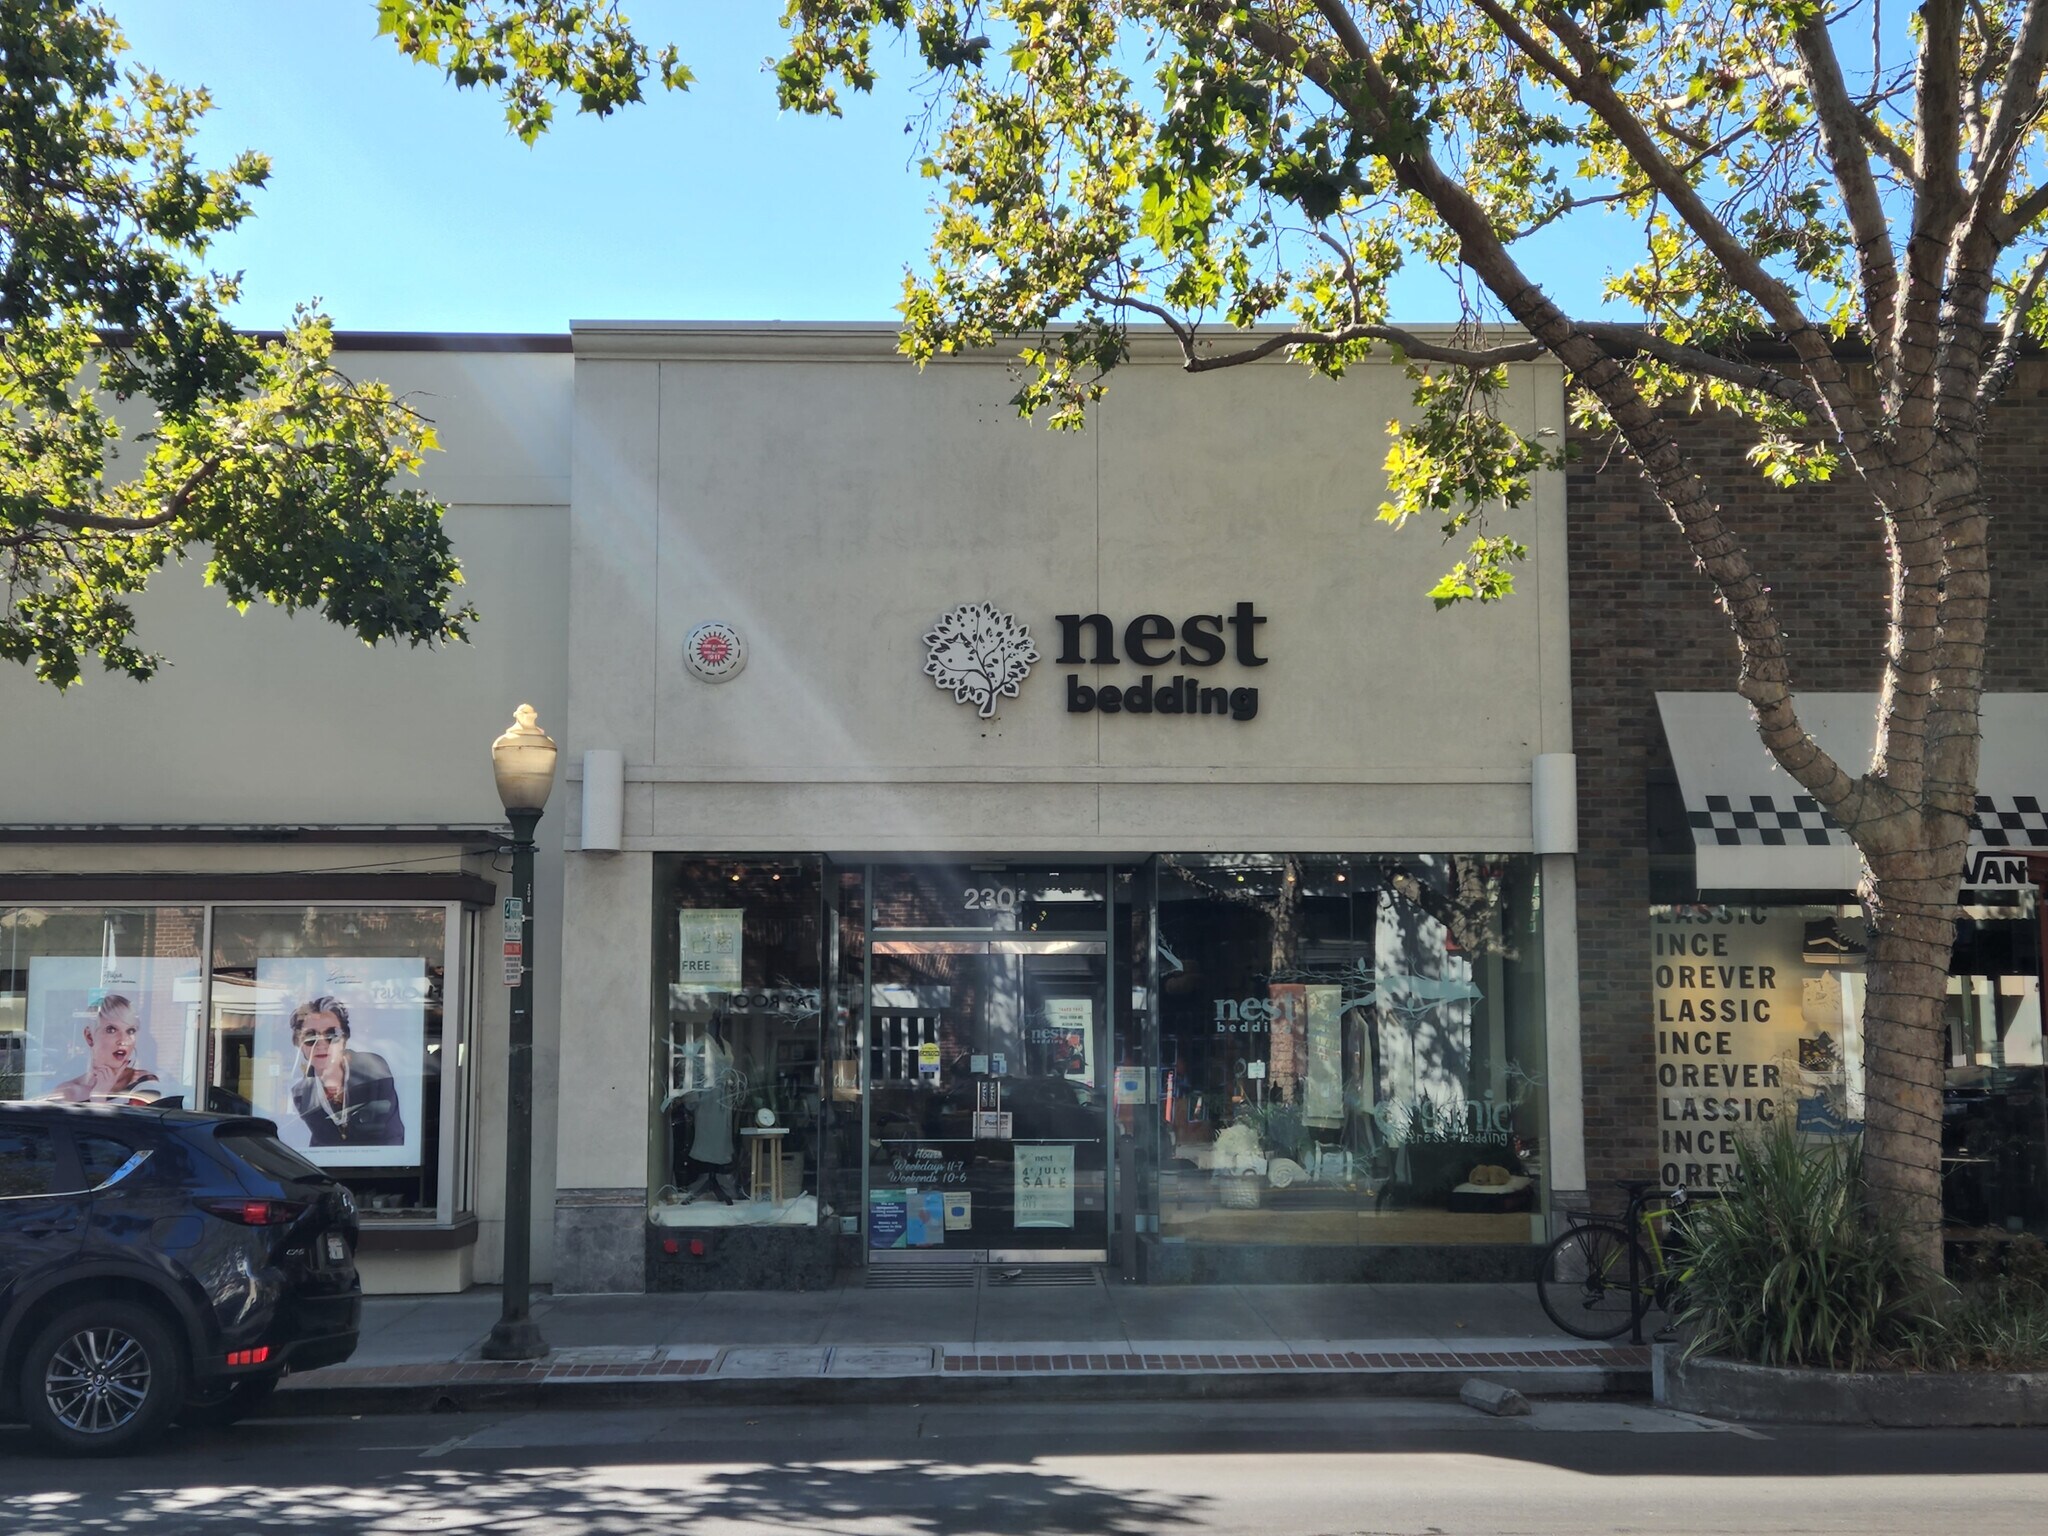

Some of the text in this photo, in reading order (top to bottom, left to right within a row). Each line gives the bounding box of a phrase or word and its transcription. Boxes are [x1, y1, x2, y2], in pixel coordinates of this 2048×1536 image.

[1055, 602, 1268, 667] nest
[1067, 675, 1258, 721] bedding
[1962, 851, 2038, 885] VAN
[963, 888, 1015, 911] 230
[1657, 905, 1767, 925] LASSIC
[1656, 933, 1728, 957] INCE
[682, 960, 710, 971] FREE
[1656, 965, 1776, 989] OREVER
[1213, 993, 1296, 1022] nest
[1659, 999, 1771, 1023] LASSIC
[1031, 1028, 1065, 1039] nest
[1217, 1021, 1292, 1034] beddig
[1659, 1031, 1732, 1055] INCE
[1659, 1063, 1780, 1088] OREVER
[1663, 1097, 1774, 1122] LASSIC
[1663, 1130, 1735, 1154] INCE
[888, 1172, 967, 1183] Weekends 10-6
[893, 1159, 964, 1174] Weekdays 11-7
[1038, 1167, 1066, 1176] JULY
[1662, 1162, 1744, 1188] OREV
[1022, 1177, 1066, 1188] SALE
